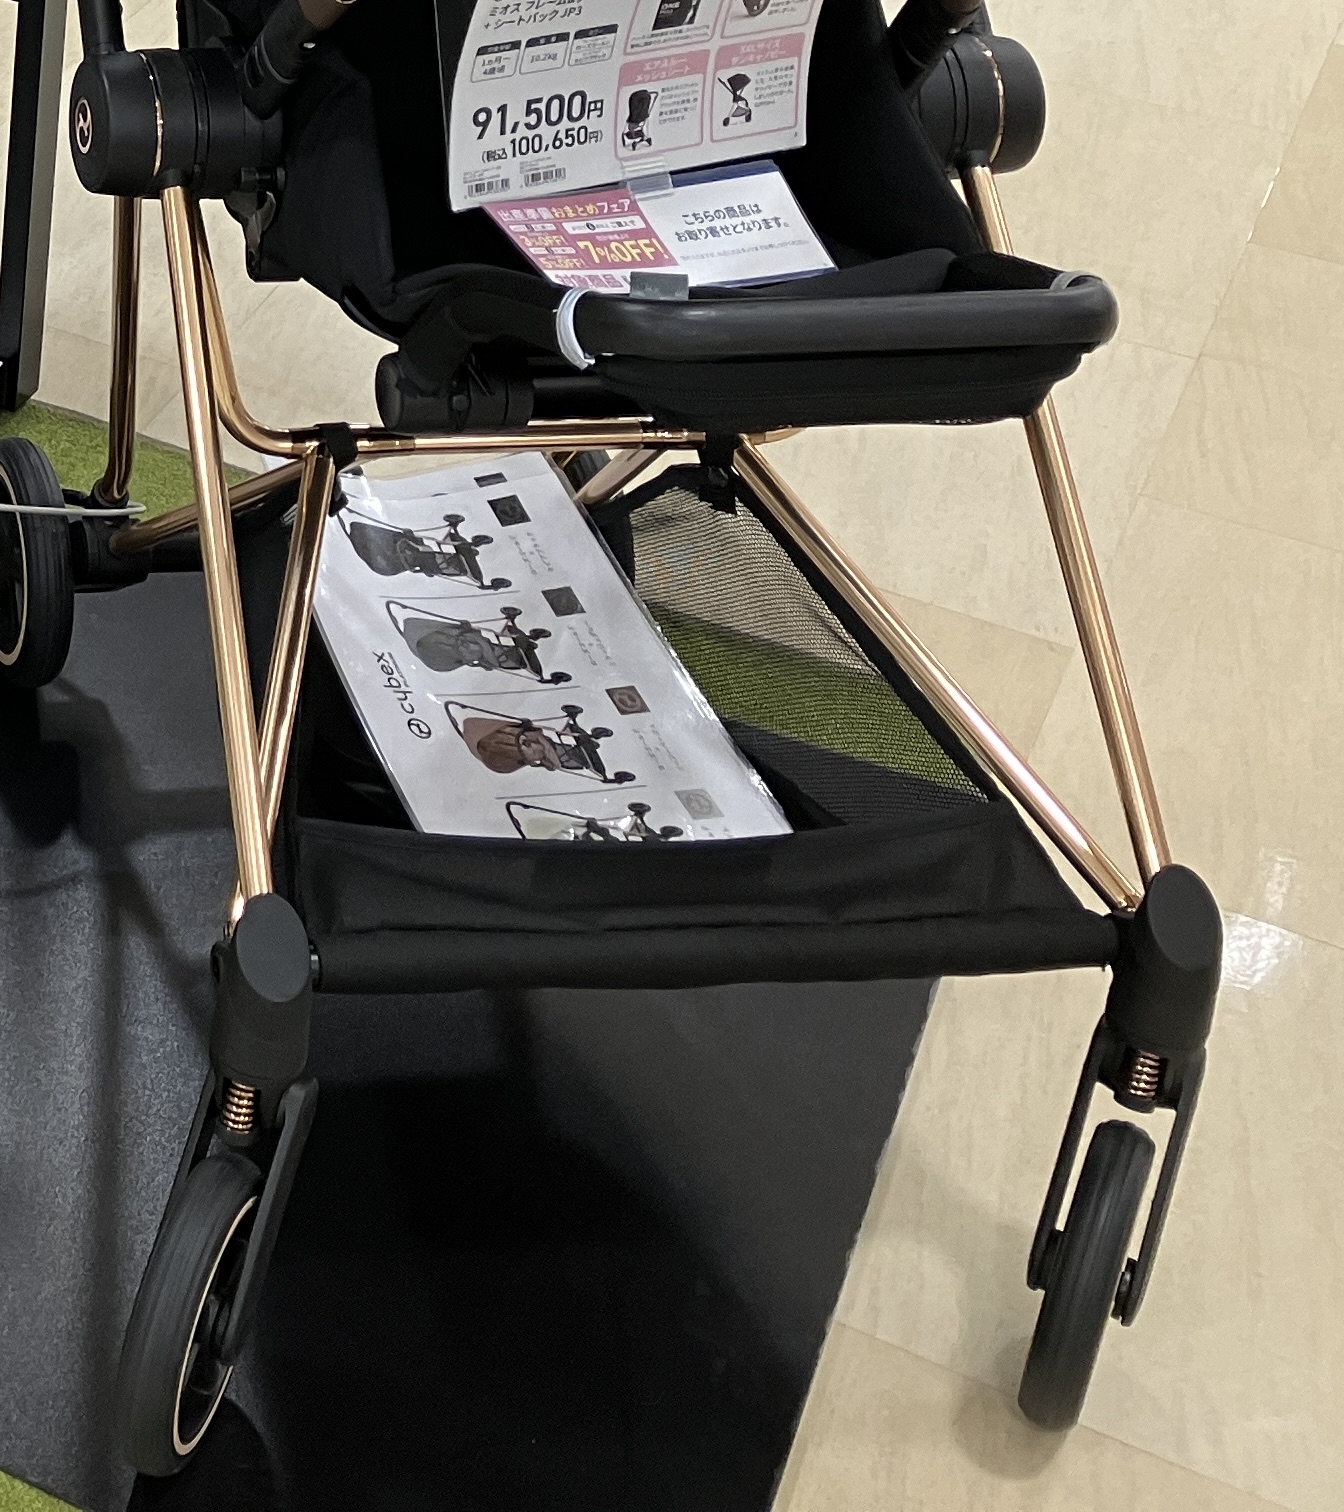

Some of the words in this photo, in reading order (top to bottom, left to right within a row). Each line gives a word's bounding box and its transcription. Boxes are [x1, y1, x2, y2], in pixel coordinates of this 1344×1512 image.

[488, 1, 523, 18] ミオス
[493, 8, 560, 30] シートバック
[559, 5, 584, 19] JP3
[471, 89, 605, 141] 91,500円
[496, 198, 632, 222] 出産準備おまとめフェア
[681, 202, 764, 226] こちらの商品は
[674, 214, 791, 244] お取り寄せとなります。
[575, 237, 670, 265] 7%OFF!
[372, 650, 416, 715] cybex
